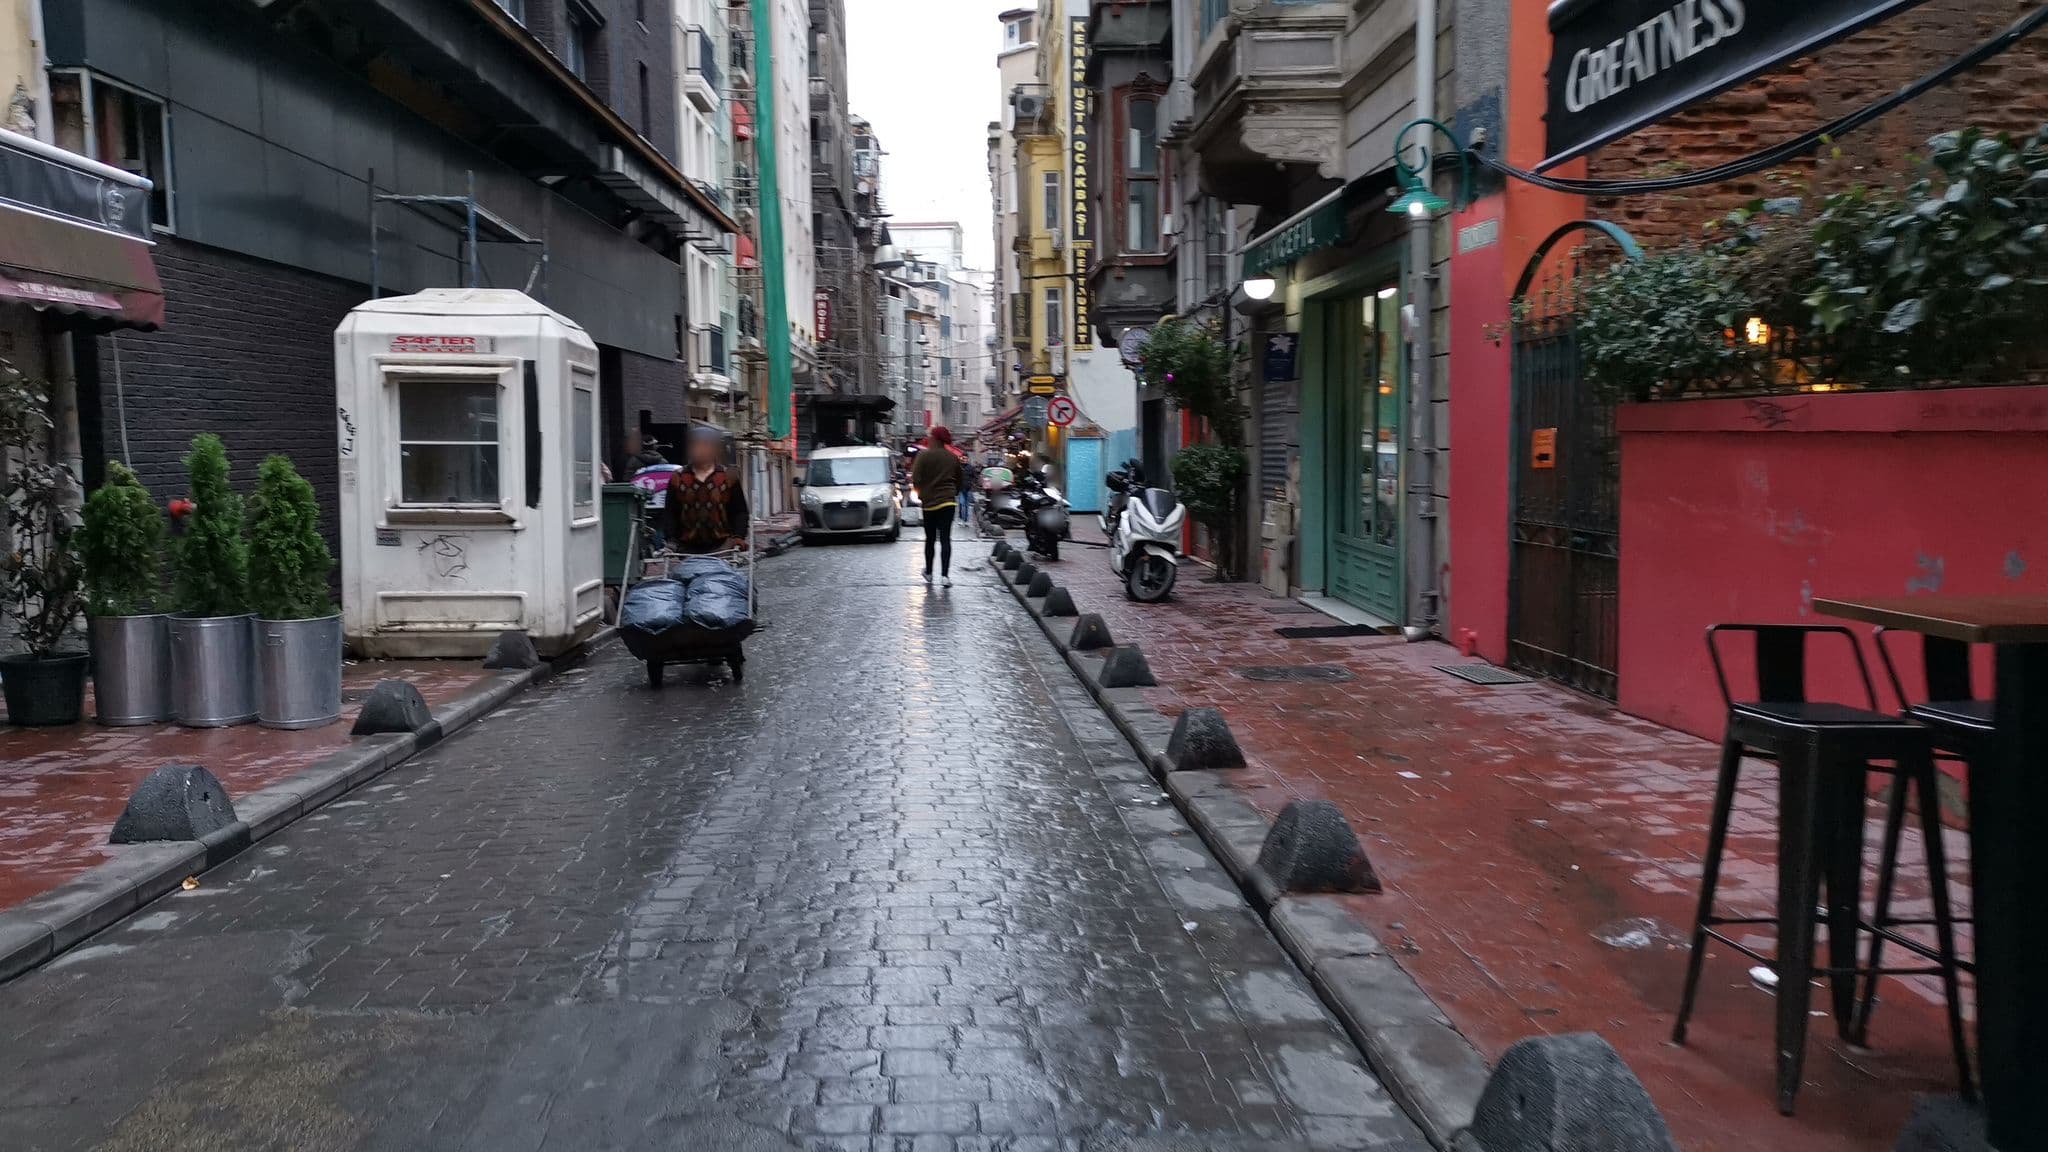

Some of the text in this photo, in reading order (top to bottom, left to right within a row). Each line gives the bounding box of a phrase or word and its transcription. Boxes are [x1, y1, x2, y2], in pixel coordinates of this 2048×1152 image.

[1072, 21, 1087, 83] KENAN
[1565, 0, 1746, 113] GREATNESS
[1073, 88, 1087, 136] USTA
[392, 335, 476, 344] SAFTER
[816, 301, 827, 339] HOTEL
